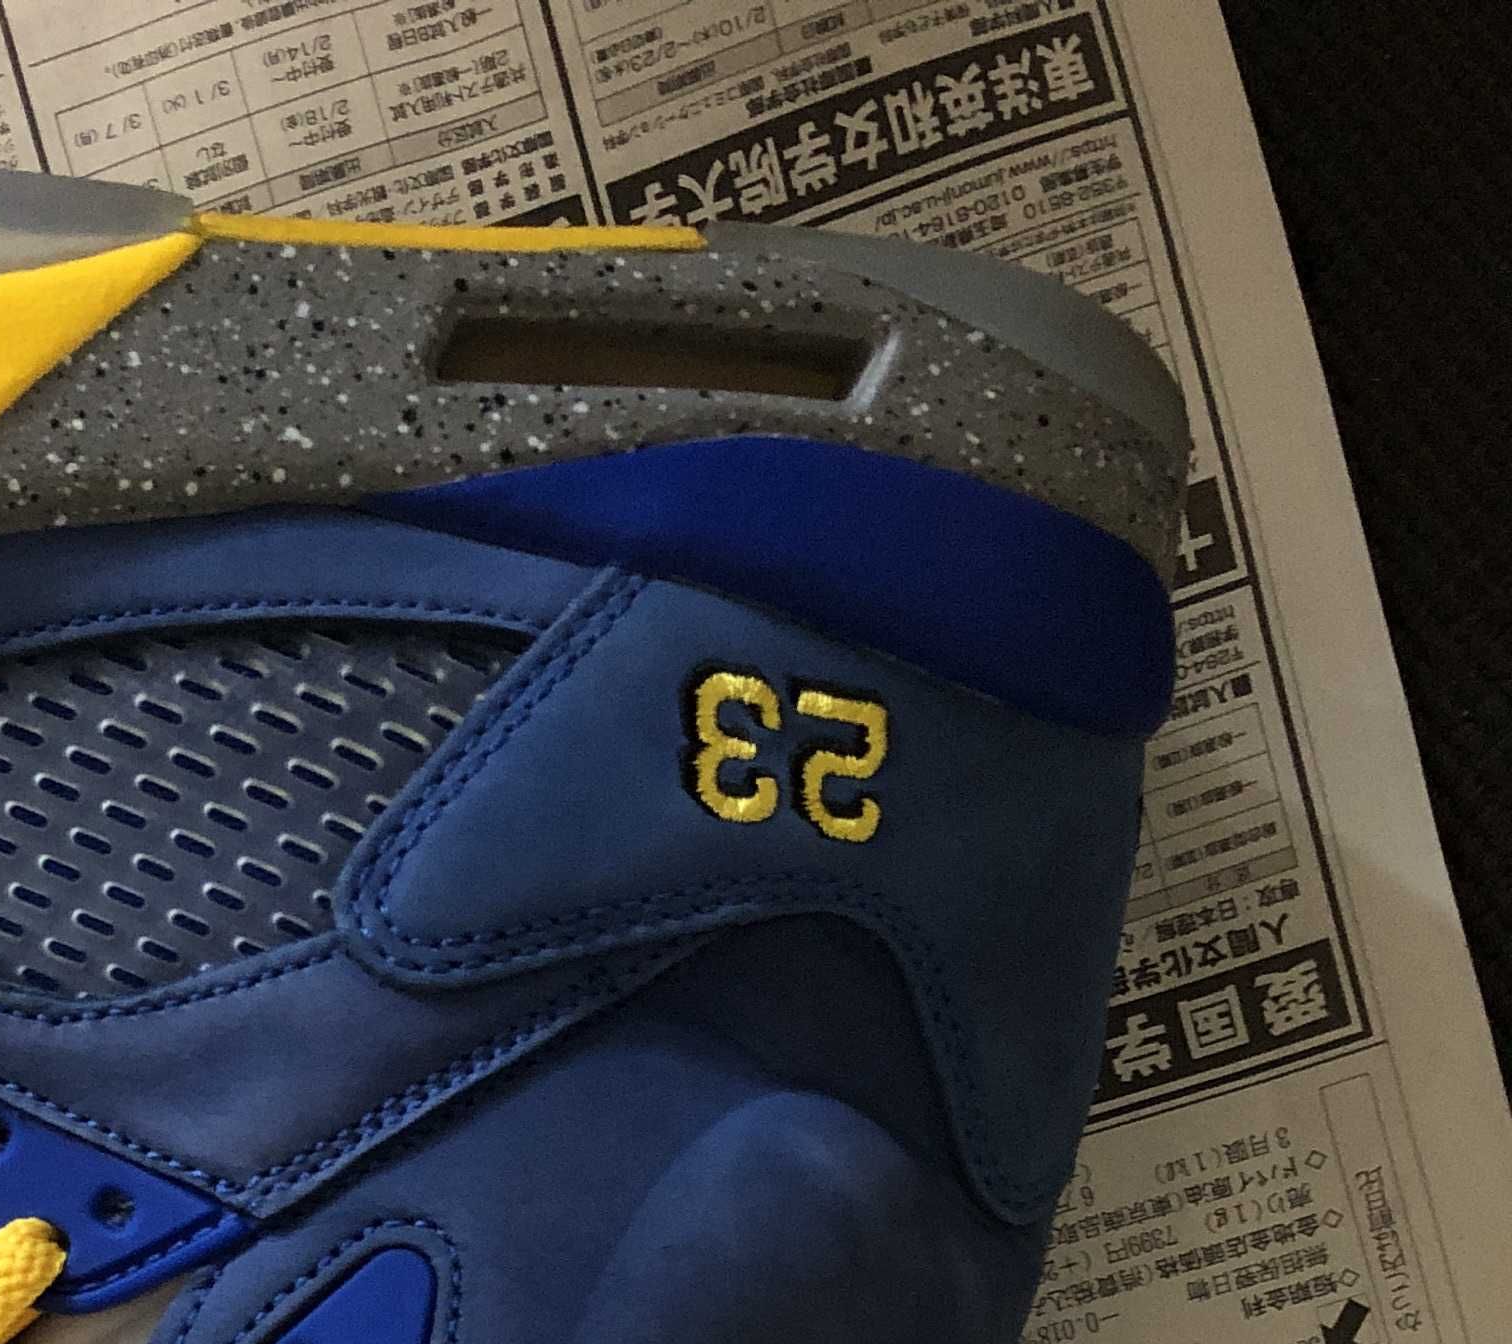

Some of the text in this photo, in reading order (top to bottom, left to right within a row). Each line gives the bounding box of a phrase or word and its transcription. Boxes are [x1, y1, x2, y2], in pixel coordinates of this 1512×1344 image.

[193, 138, 226, 164] なし
[693, 670, 888, 842] 23
[1098, 954, 1332, 1085] 愛国学
[1238, 1270, 1339, 1320] 短期金利
